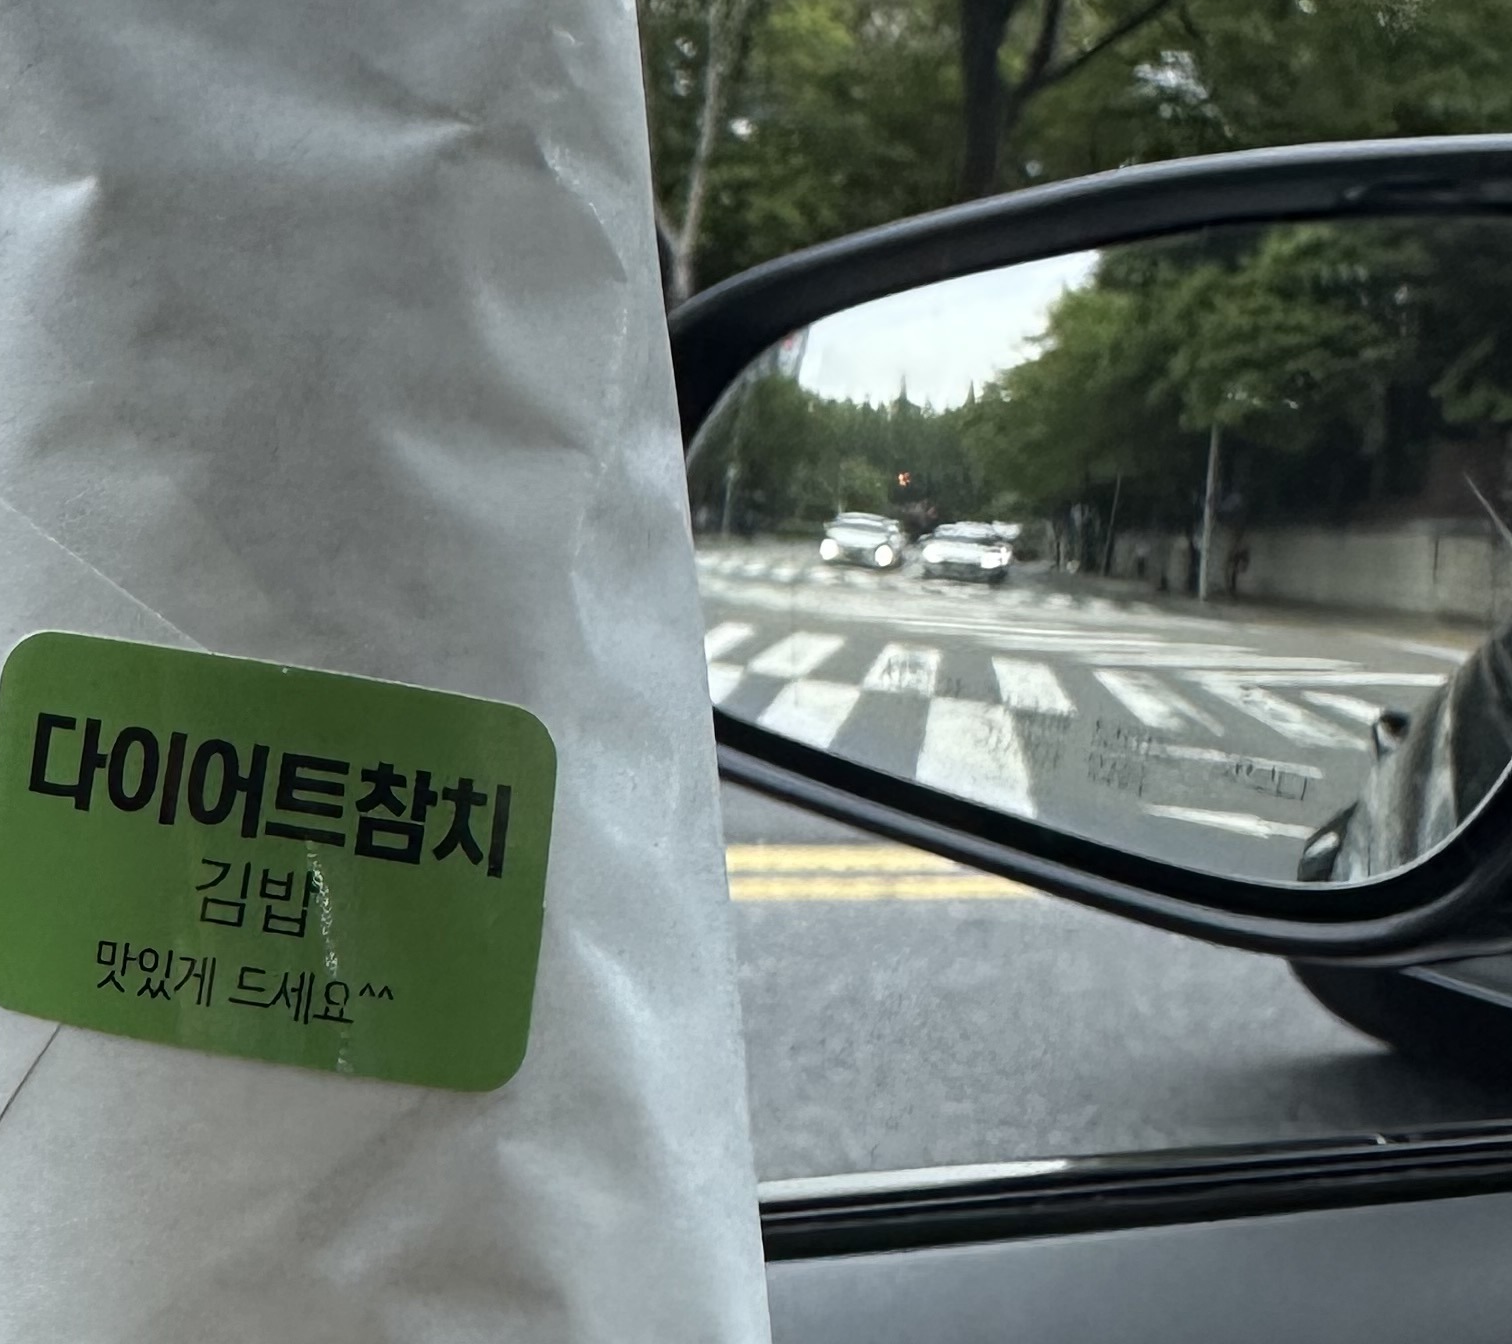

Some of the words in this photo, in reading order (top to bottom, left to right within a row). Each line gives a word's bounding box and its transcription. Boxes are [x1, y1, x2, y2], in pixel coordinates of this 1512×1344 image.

[28, 711, 512, 878] 다이어트참치
[195, 858, 322, 938] 김밥
[95, 940, 217, 1007] 맛있게
